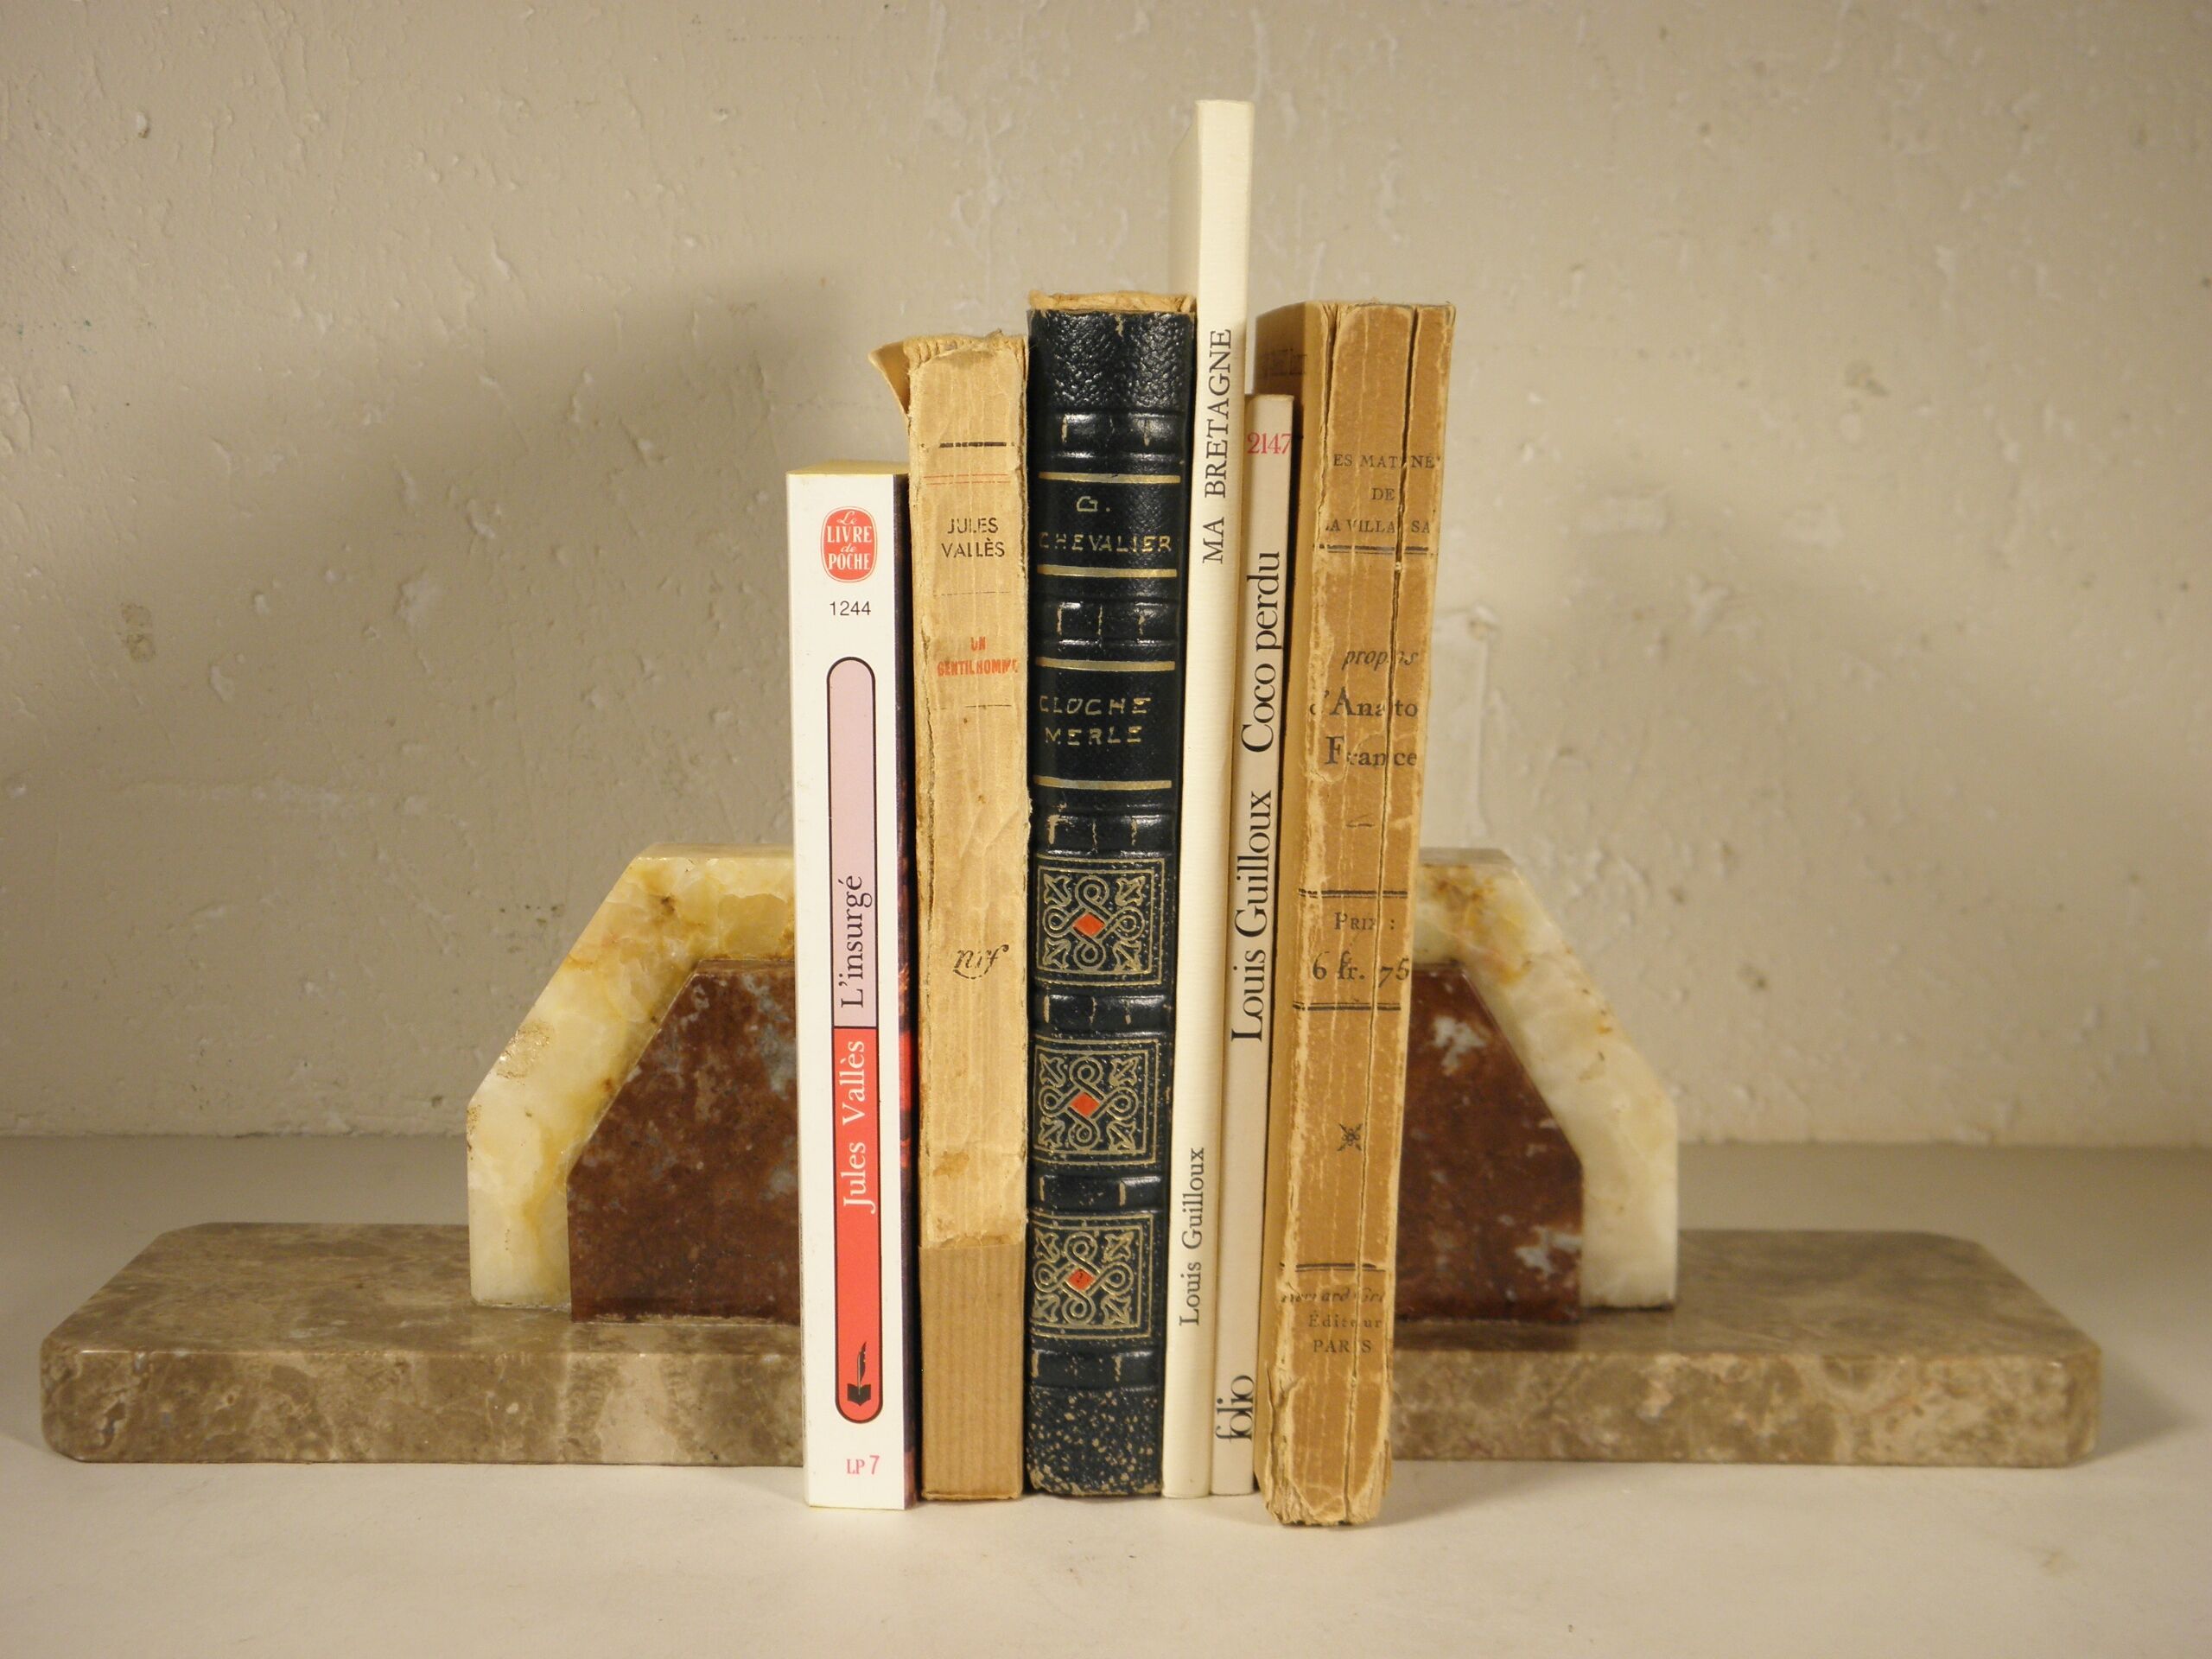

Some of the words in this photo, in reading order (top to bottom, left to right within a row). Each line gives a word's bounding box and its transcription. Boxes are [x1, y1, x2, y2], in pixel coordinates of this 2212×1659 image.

[1205, 329, 1232, 498] BRETAGNE
[1247, 432, 1293, 454] 2147
[1371, 487, 1395, 500] DE
[836, 511, 856, 525] Le
[947, 518, 998, 534] JULES
[827, 525, 872, 543] LIVRE
[1039, 532, 1172, 553] CHEVALIER
[1203, 518, 1224, 563] MA
[840, 544, 856, 553] de
[942, 537, 1005, 557] VALLÈS
[828, 553, 870, 570] POCHE
[830, 601, 871, 615] 1244
[1246, 551, 1282, 652] perdu
[970, 637, 986, 651] UN
[1039, 696, 1151, 715] CLOCHE
[1241, 663, 1276, 753] Coco
[1045, 726, 1142, 746] MERLE
[1234, 790, 1272, 938] Guilloux
[838, 875, 873, 1008] L'insurgé
[1313, 951, 1330, 980] 6
[1338, 950, 1365, 980] fr.
[1378, 957, 1409, 988] 75
[1230, 949, 1266, 1042] Louis
[840, 1041, 865, 1125] Vallès
[841, 1142, 875, 1215] Jules
[1182, 1147, 1205, 1250] Guilloux
[1179, 1262, 1201, 1326] Louis
[1313, 1340, 1372, 1353] PARS
[1216, 1375, 1255, 1441] folio
[847, 1459, 865, 1474] LP
[869, 1455, 880, 1474] 7
